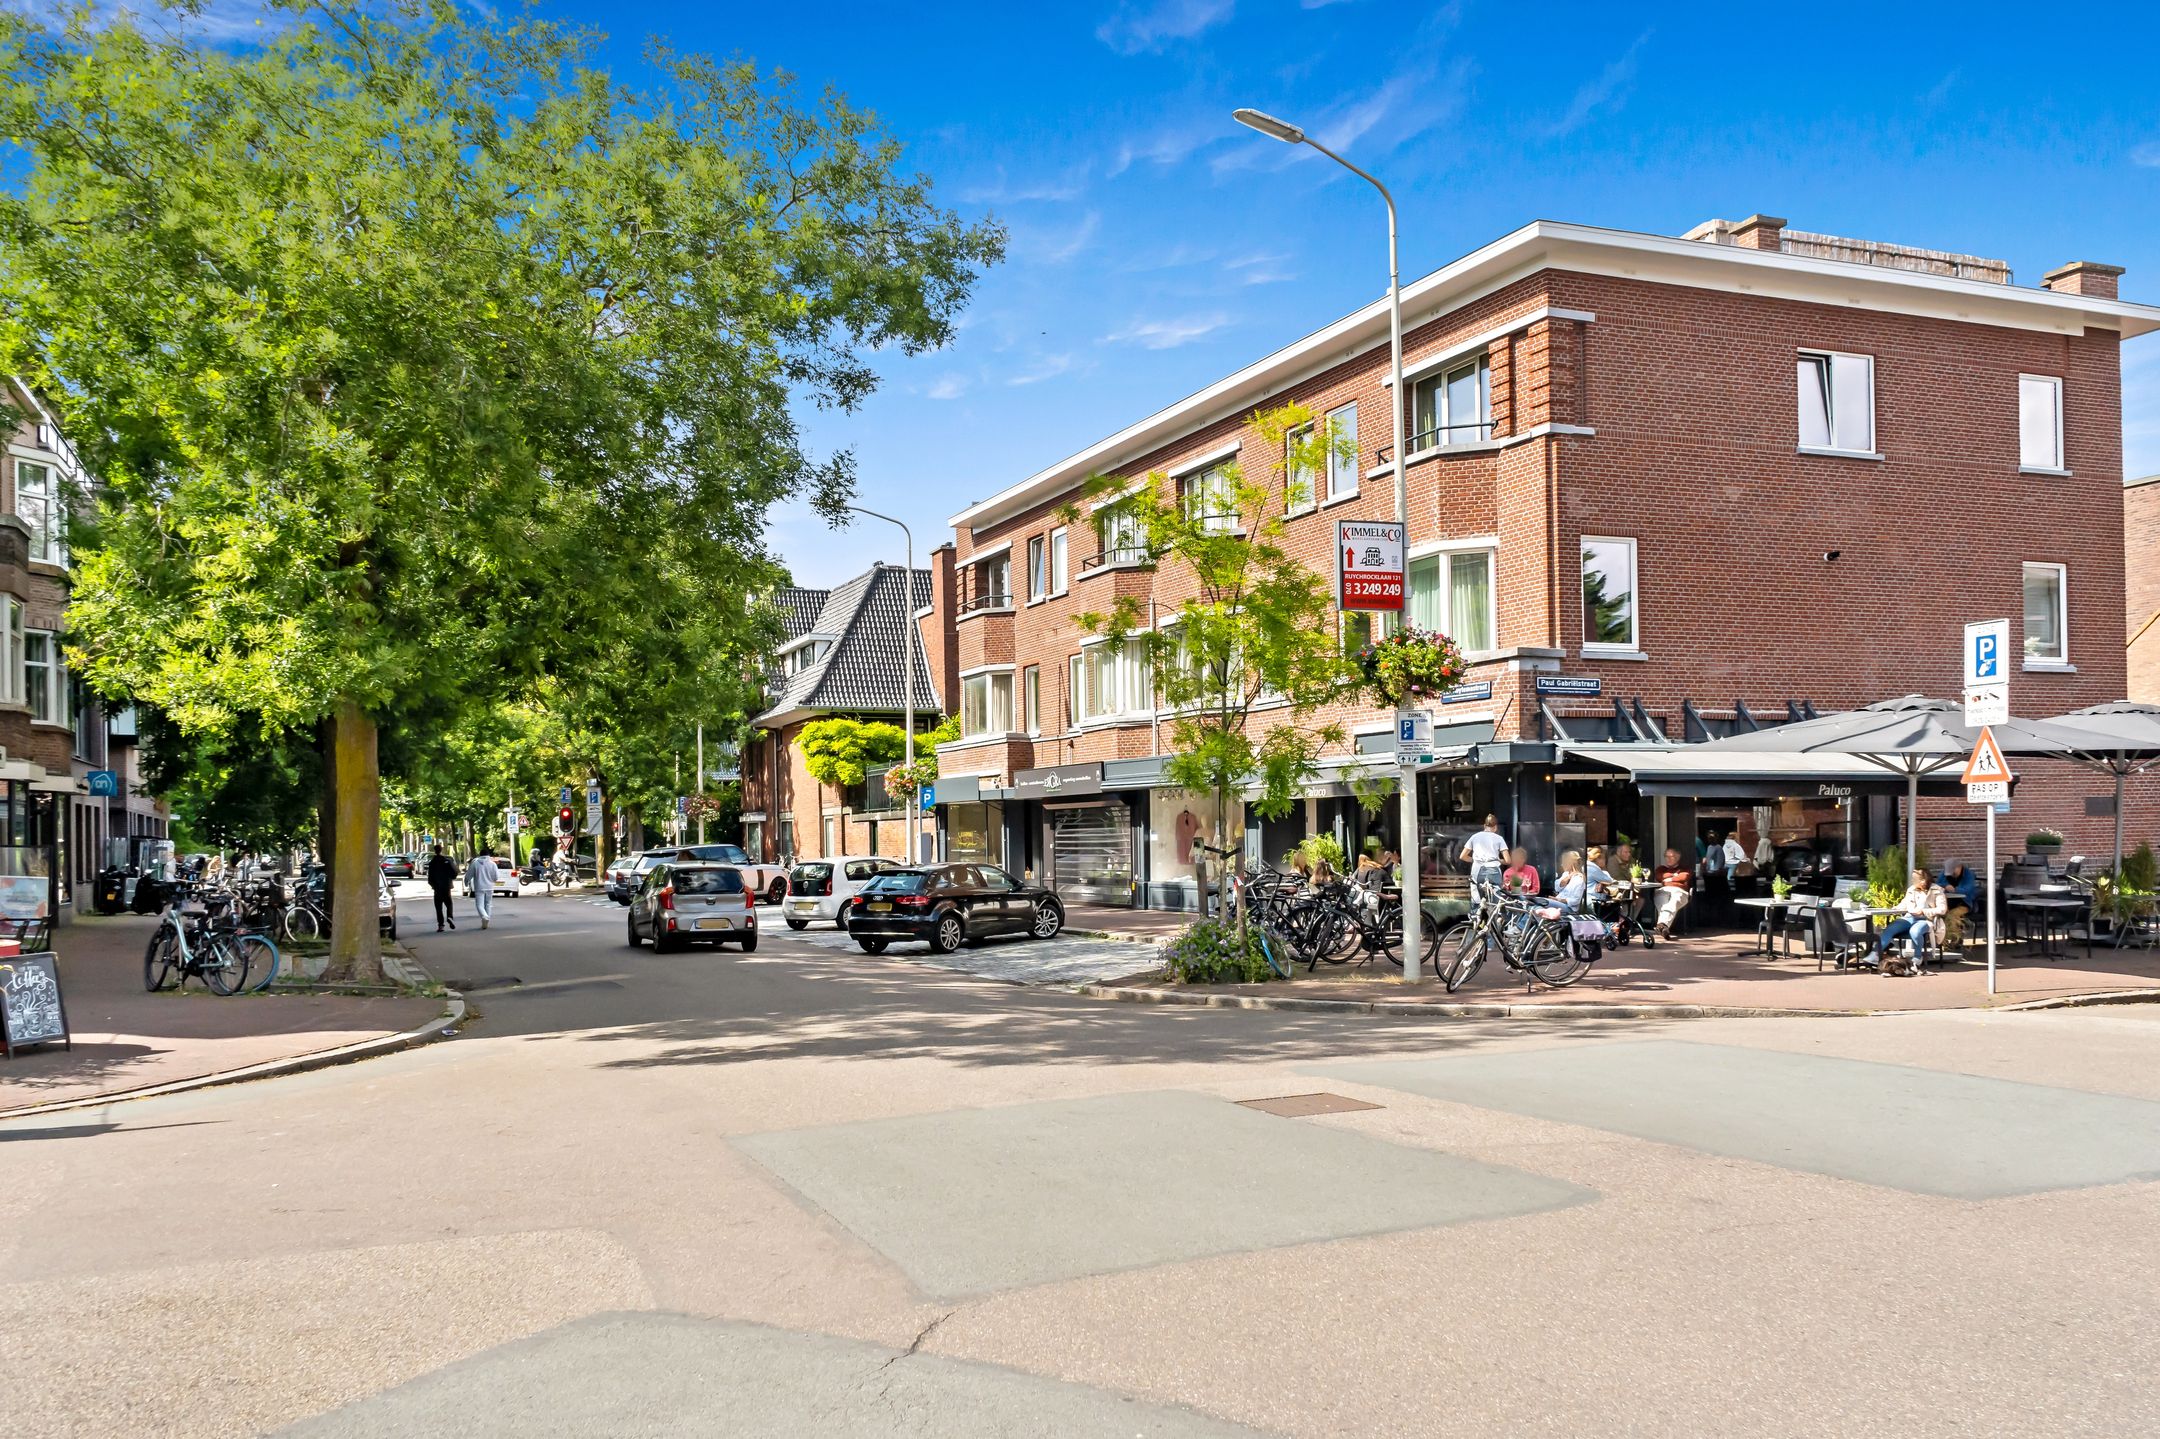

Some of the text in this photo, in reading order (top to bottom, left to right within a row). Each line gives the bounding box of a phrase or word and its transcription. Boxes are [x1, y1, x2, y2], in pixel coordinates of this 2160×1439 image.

[1342, 527, 1401, 541] KIMMEL&CO
[1353, 582, 1361, 595] 3
[1362, 582, 1382, 595] 249
[1382, 583, 1401, 596] 249
[1980, 638, 1994, 660] P
[1404, 721, 1411, 731] P
[1818, 784, 1851, 796] Paluco
[1972, 783, 1986, 794] PAS
